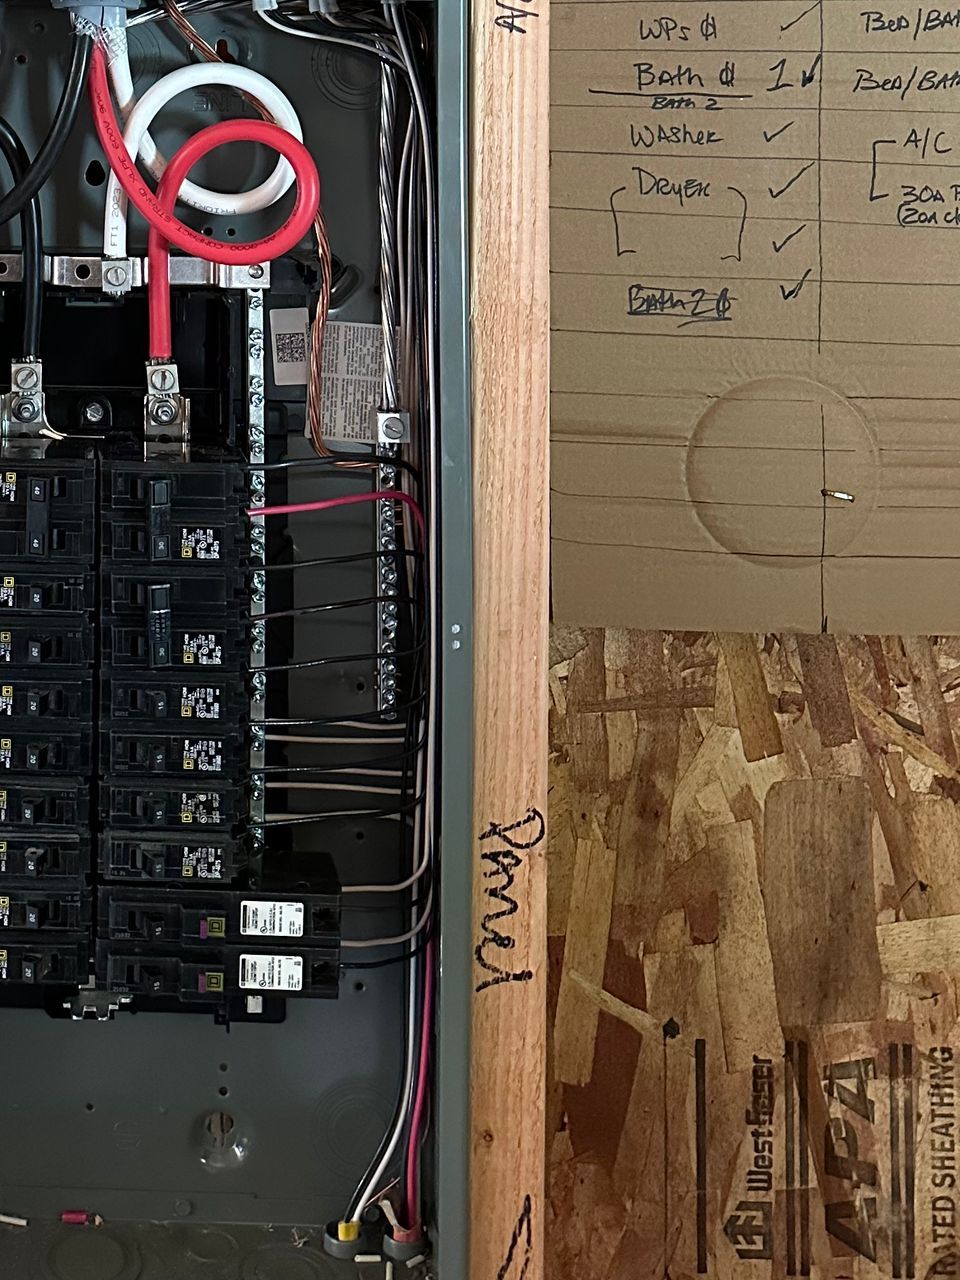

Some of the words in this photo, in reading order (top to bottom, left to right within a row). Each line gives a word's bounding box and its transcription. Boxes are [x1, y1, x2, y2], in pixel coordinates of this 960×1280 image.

[704, 97, 724, 111] 2
[101, 119, 121, 150] 600V
[902, 126, 954, 160] A/C
[117, 155, 138, 184] XLPE
[111, 187, 121, 218] 2023
[137, 186, 173, 224] STRAND
[110, 225, 119, 247] FT1
[32, 647, 38, 657] 20
[30, 702, 37, 711] 20
[30, 754, 36, 764] 20
[928, 1045, 956, 1188] SHEATHING
[823, 1057, 879, 1265] APA
[929, 1195, 957, 1277] RATED
